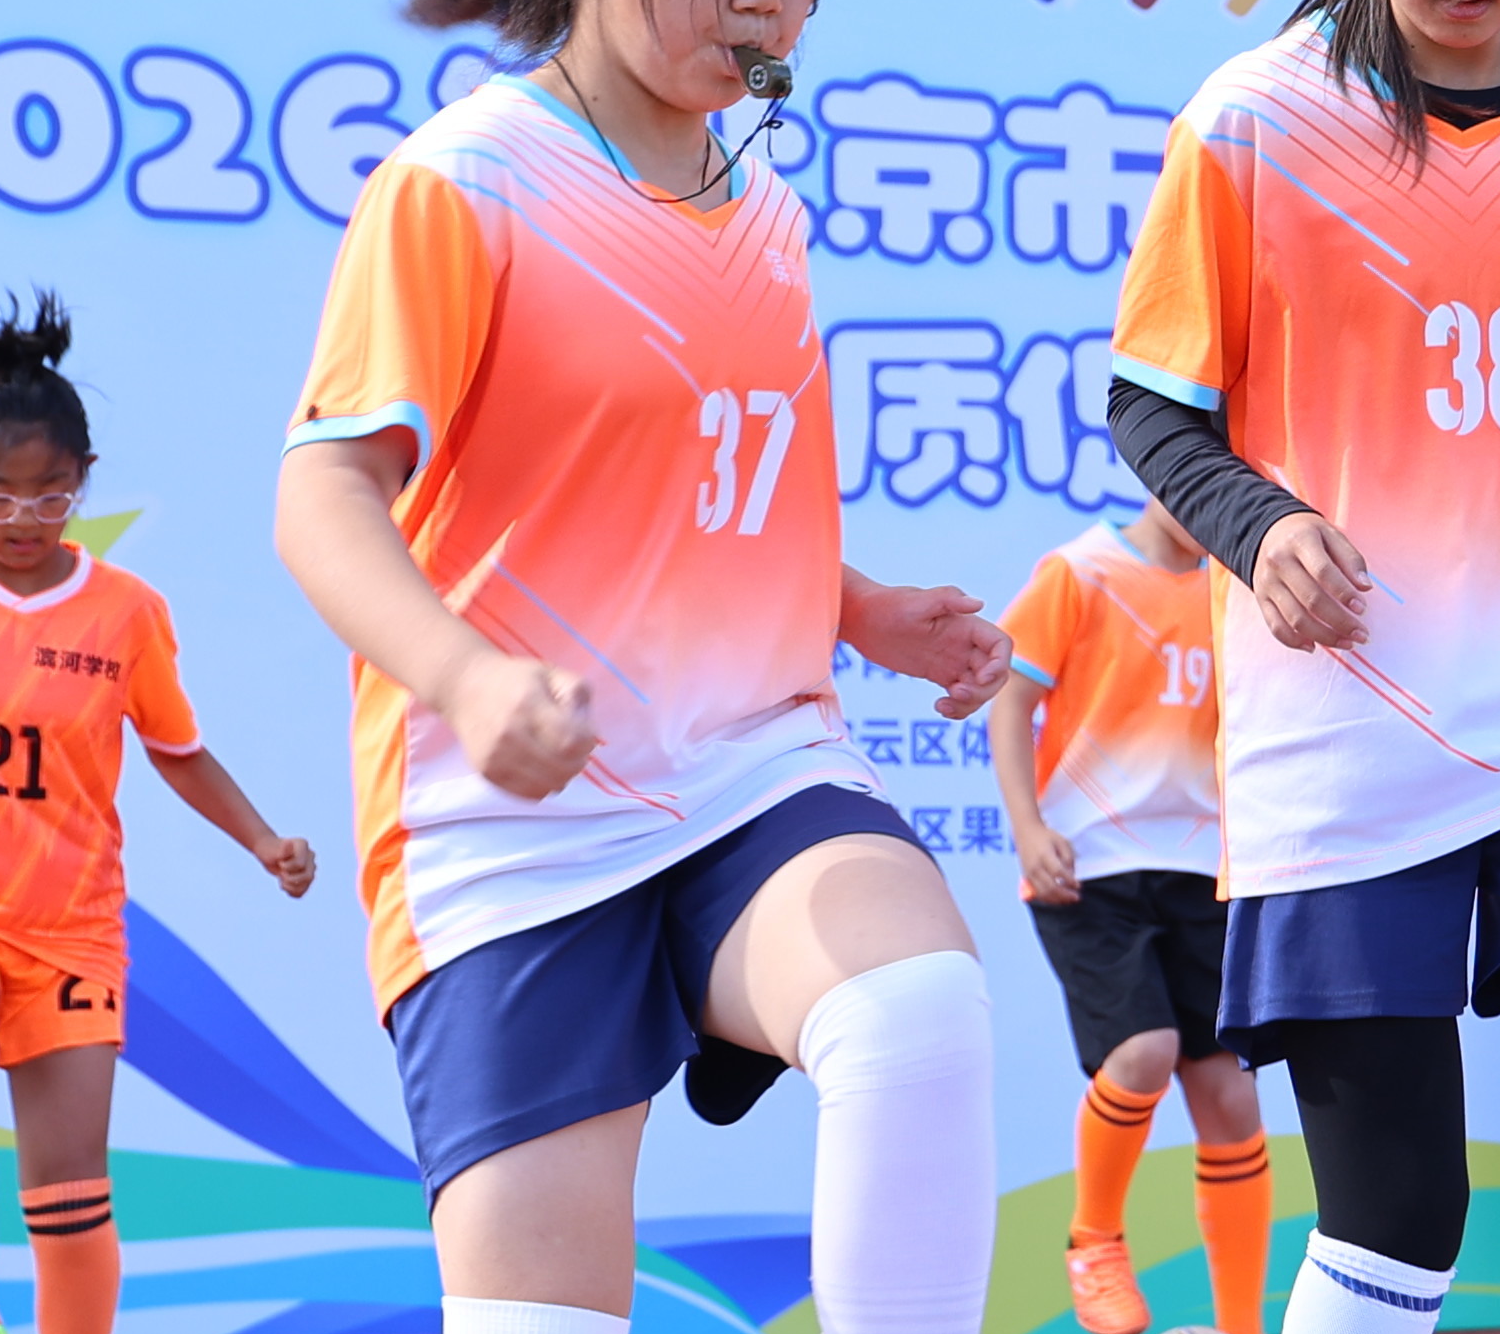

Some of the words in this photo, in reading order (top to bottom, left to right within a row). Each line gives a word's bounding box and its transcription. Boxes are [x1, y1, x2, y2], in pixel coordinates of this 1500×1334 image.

[696, 386, 798, 537] 37
[33, 645, 122, 683] 滨河学校
[1157, 641, 1212, 708] 19
